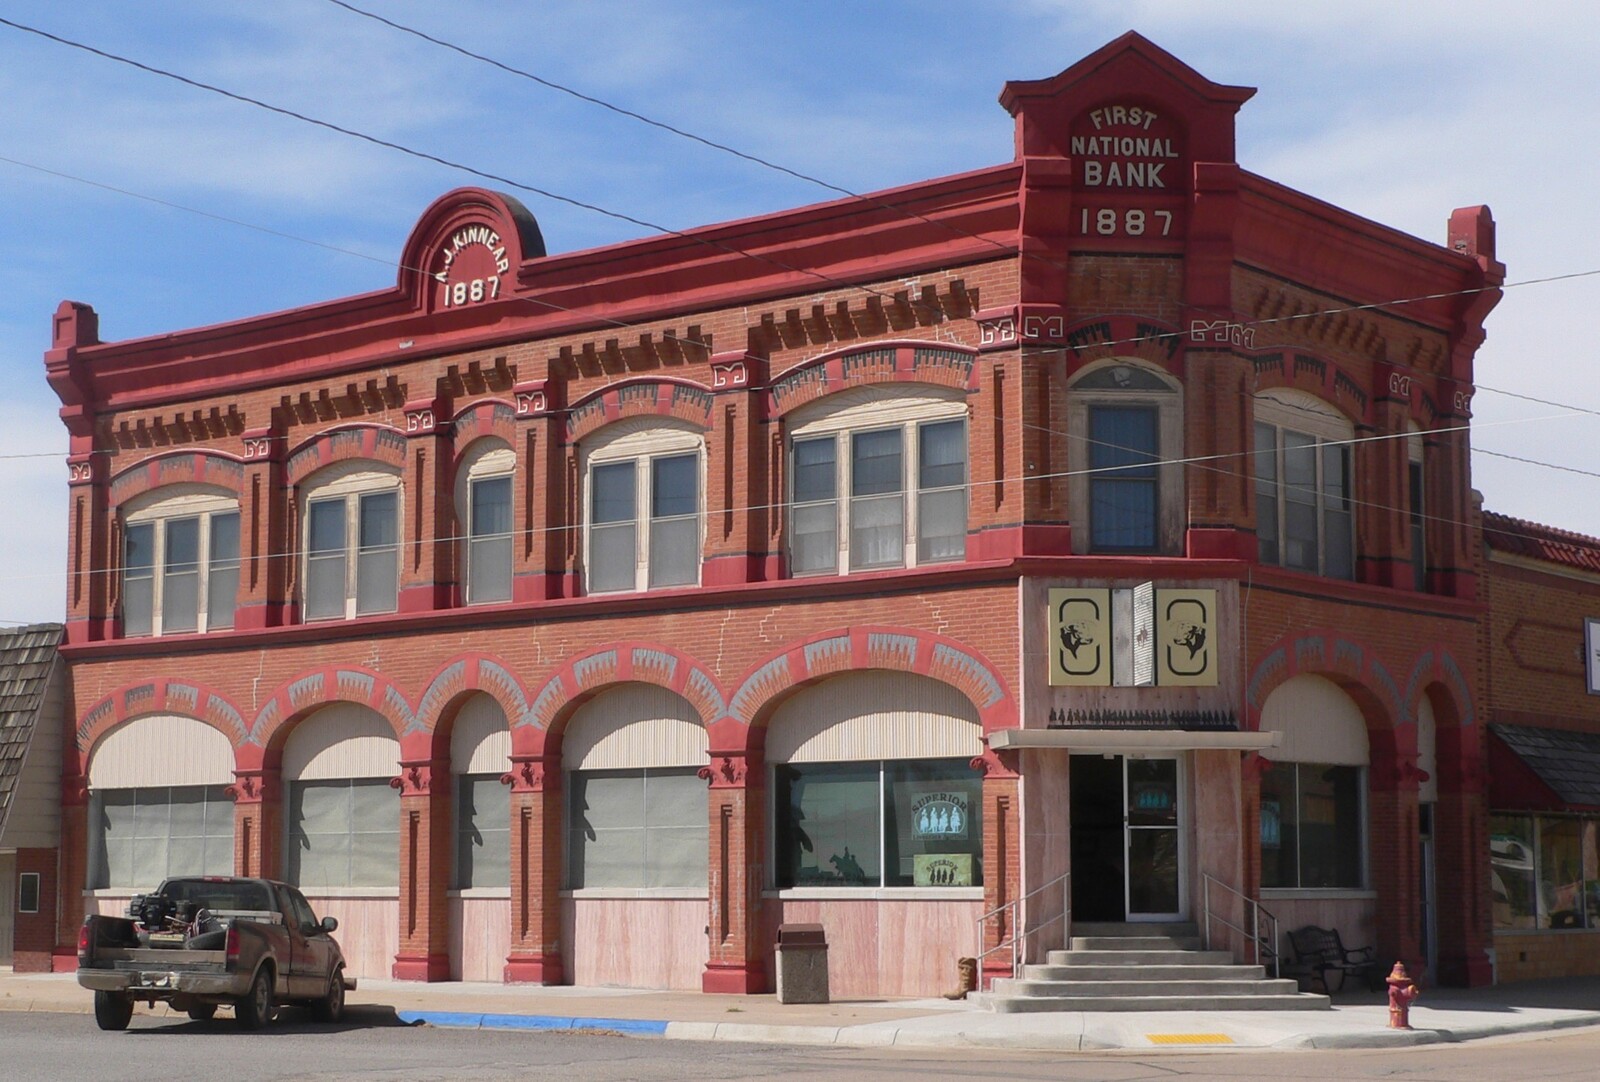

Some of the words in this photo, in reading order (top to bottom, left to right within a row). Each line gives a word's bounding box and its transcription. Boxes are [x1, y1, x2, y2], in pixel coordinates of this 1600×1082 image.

[1090, 106, 1157, 130] FIRST
[1071, 136, 1178, 158] NATIONAL
[1084, 161, 1165, 188] BANK
[1081, 208, 1172, 236] 1887
[444, 276, 499, 306] 1887
[912, 793, 967, 814] SUPERIOR
